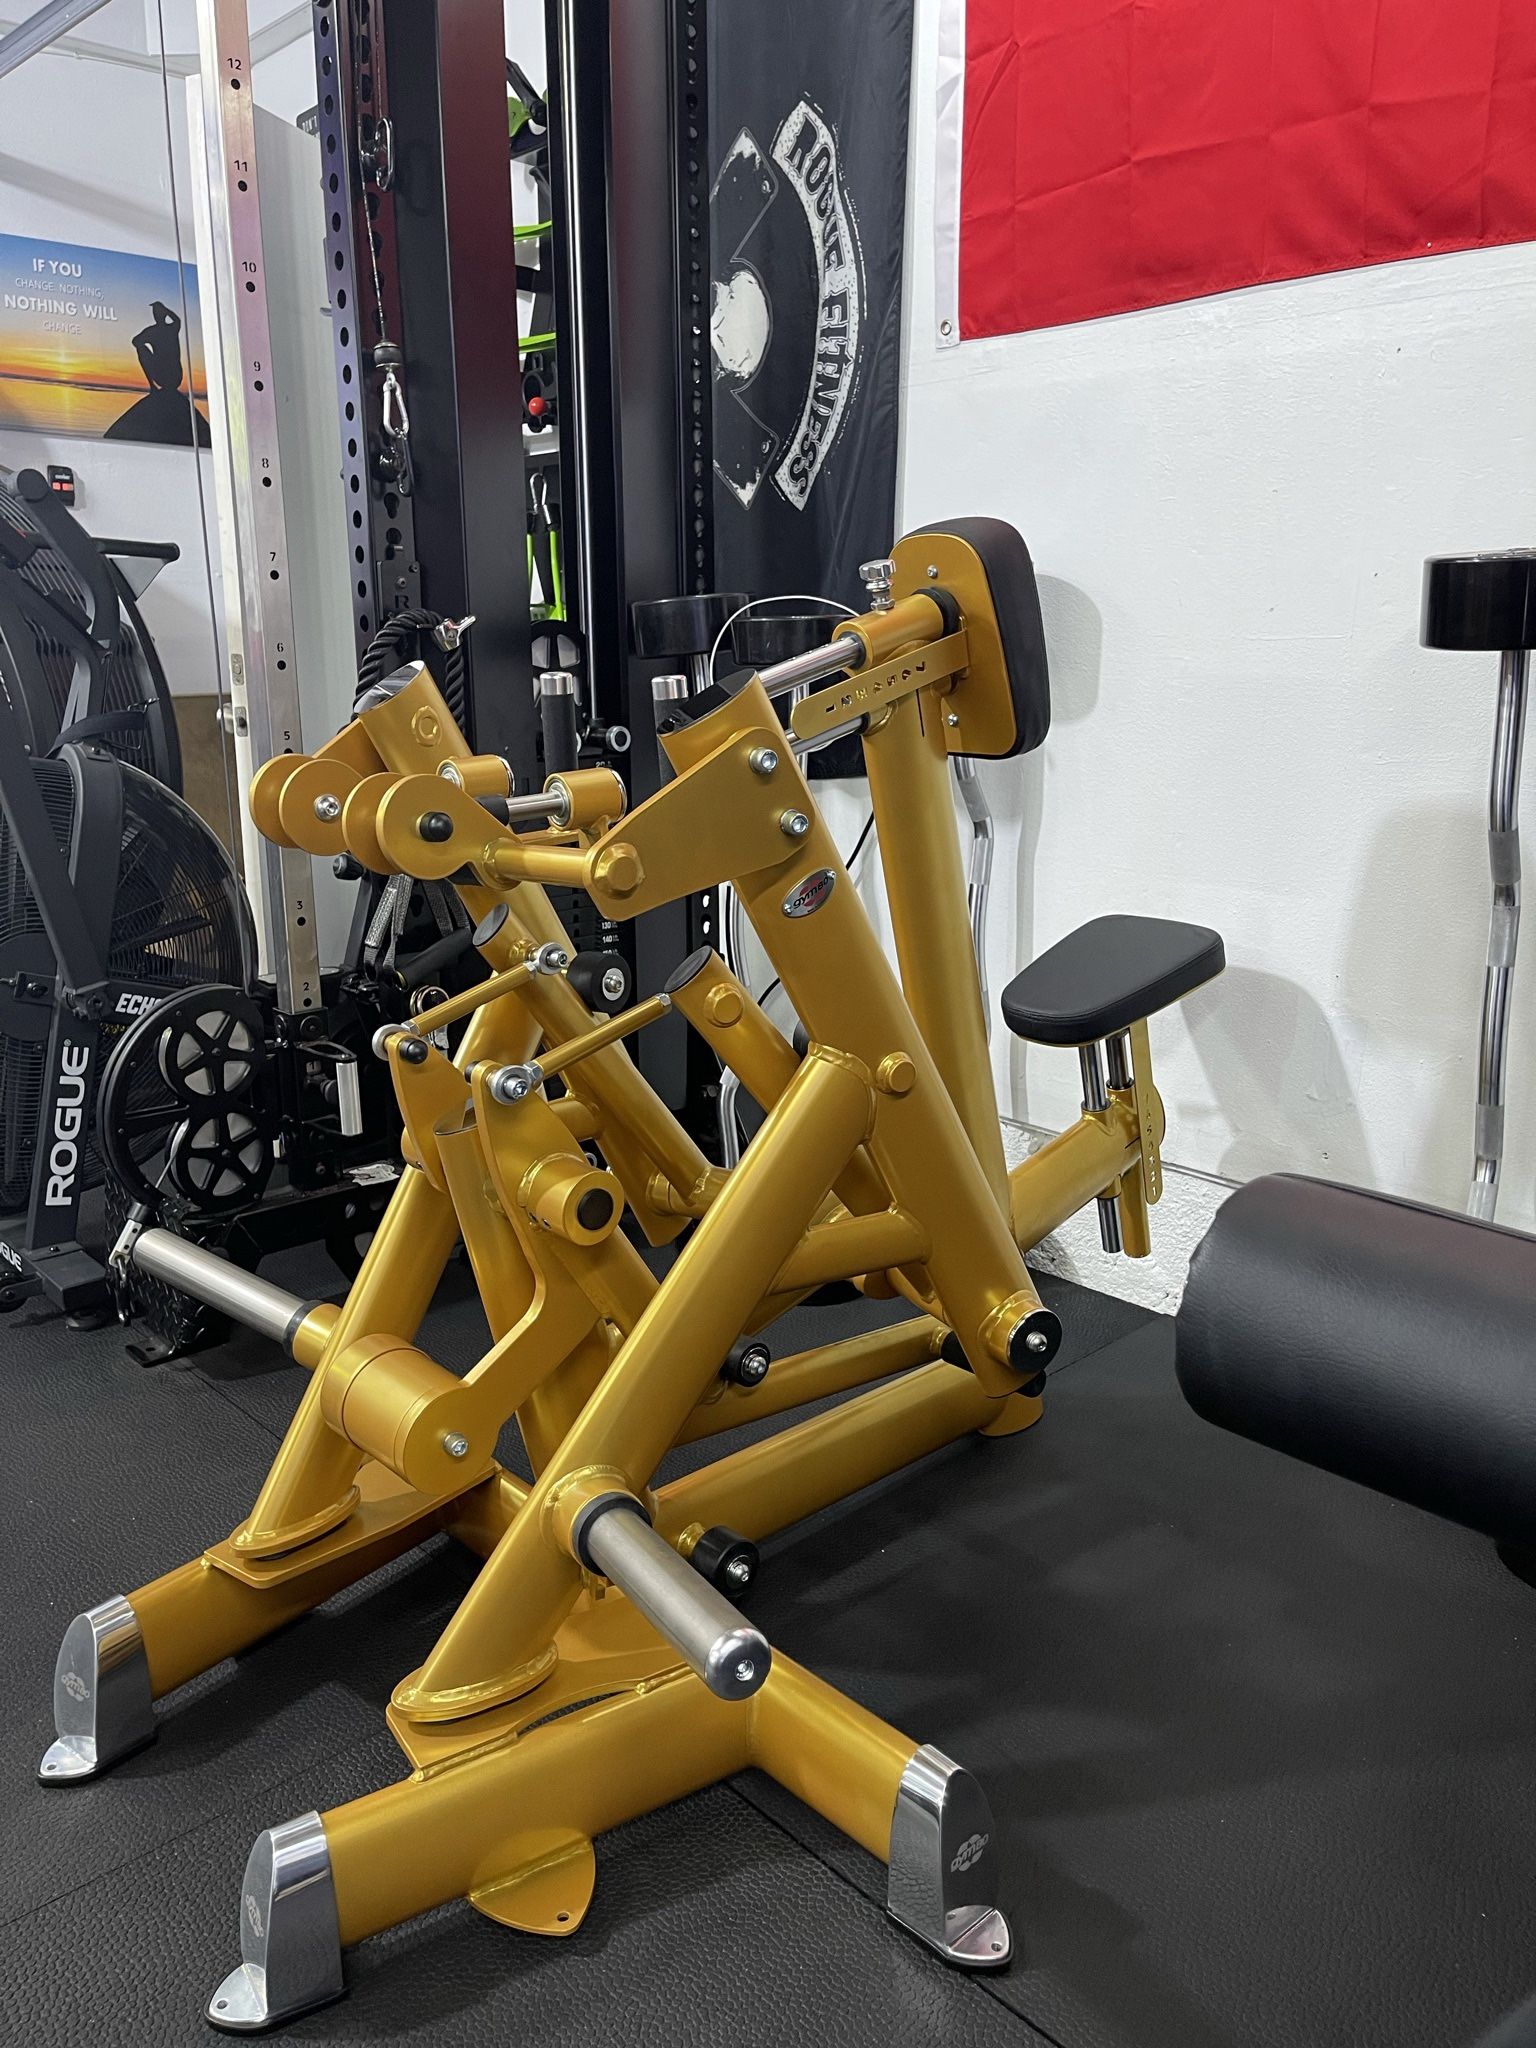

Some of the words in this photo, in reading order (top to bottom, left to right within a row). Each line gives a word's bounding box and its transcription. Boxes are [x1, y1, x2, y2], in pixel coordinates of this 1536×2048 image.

[227, 57, 242, 71] 12
[234, 160, 248, 172] 11
[785, 113, 846, 271] ROGUE
[32, 258, 45, 272] IF
[50, 261, 82, 278] YOU
[241, 261, 257, 273] 10
[15, 278, 54, 293] CHANGE
[4, 294, 77, 317] NOTHING
[83, 305, 118, 322] WILL
[43, 321, 82, 335] CHANGE
[253, 361, 261, 372] 9
[788, 287, 854, 497] FITNESS
[262, 458, 269, 469] 8
[270, 552, 276, 561] 7
[277, 642, 284, 653] 6
[284, 730, 290, 741] 5
[297, 900, 303, 910] 3
[602, 934, 613, 943] 140
[303, 981, 309, 991] 2
[115, 993, 163, 1016] ECH
[45, 1046, 90, 1206] ROGUE
[0, 1241, 22, 1272] GUE
